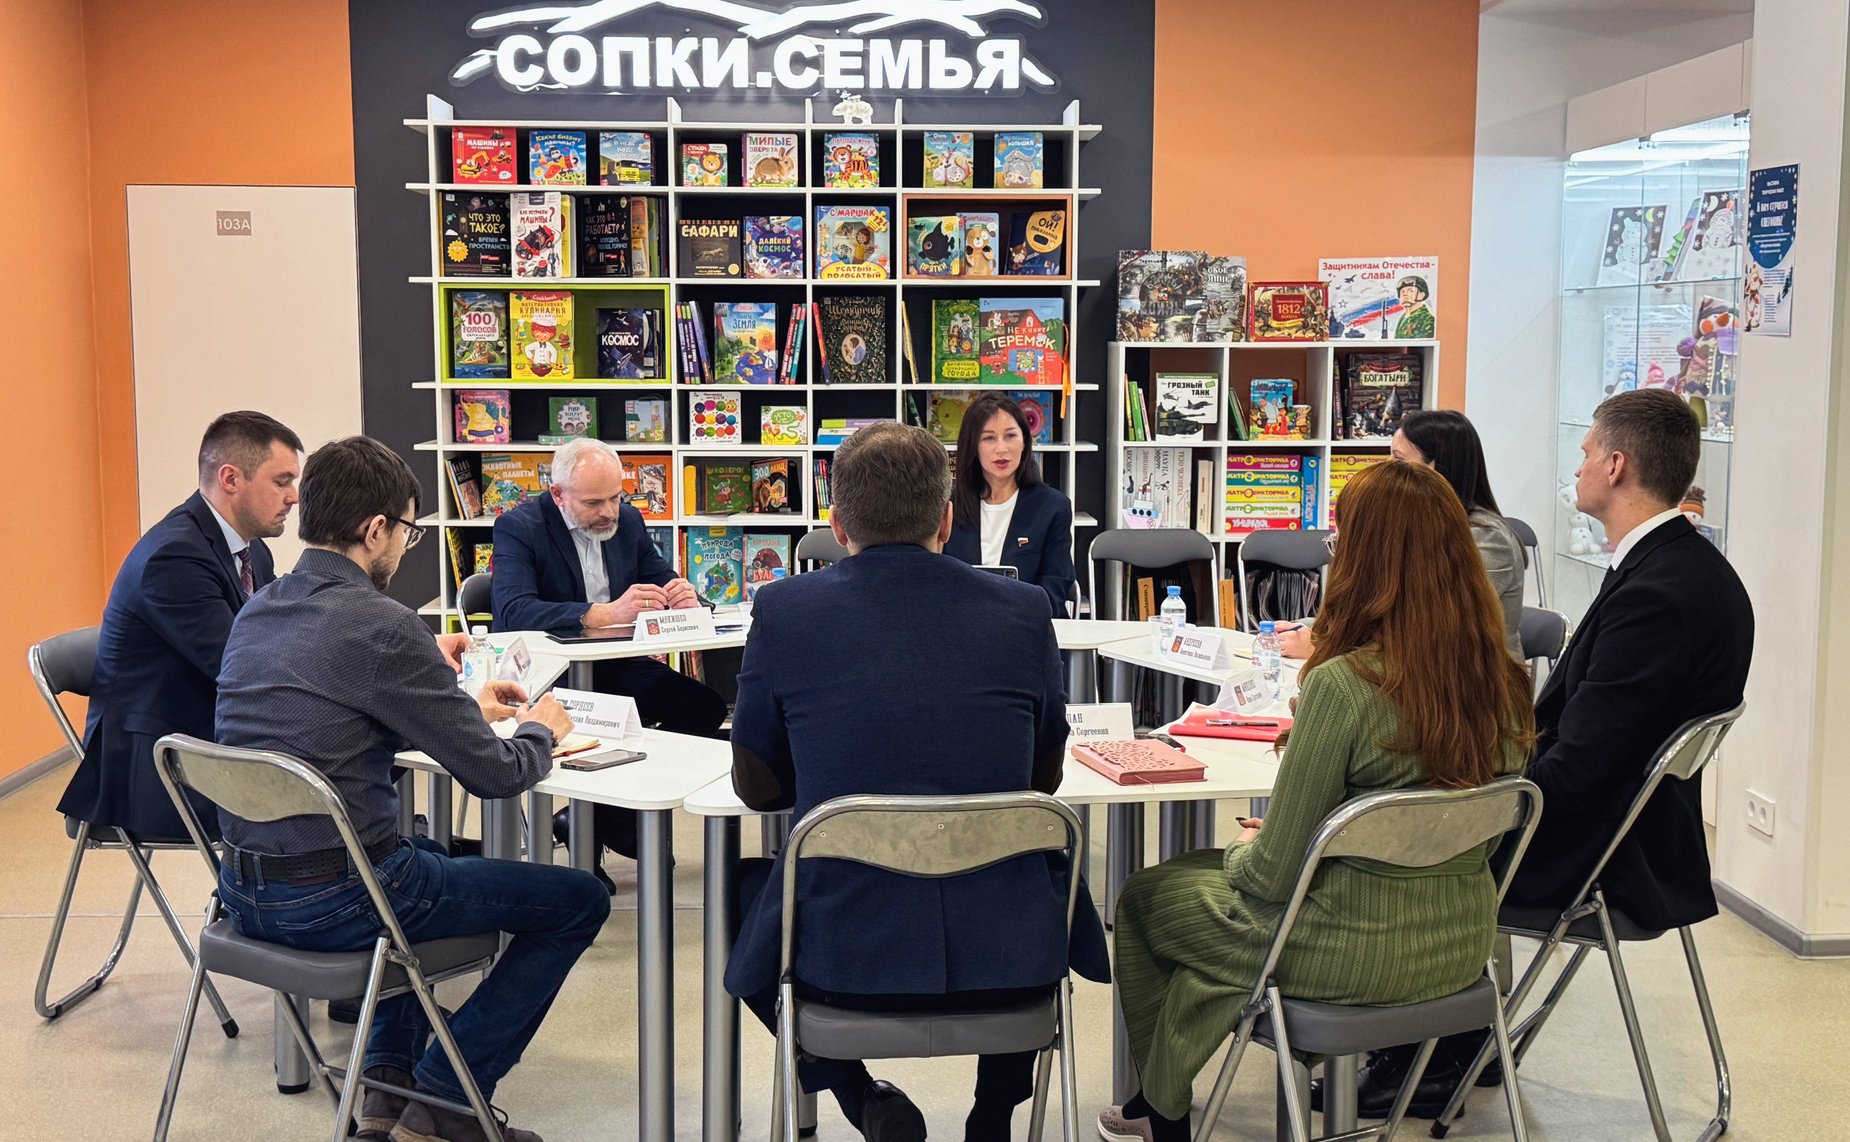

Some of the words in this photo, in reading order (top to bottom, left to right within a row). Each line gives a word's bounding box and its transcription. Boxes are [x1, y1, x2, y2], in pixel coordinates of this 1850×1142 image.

[496, 34, 1020, 88] СОПКИ.СЕМЬЯ
[466, 139, 499, 147] МАШИНЫ
[749, 137, 792, 146] МИЛЫЕ
[468, 212, 484, 222] ЧТО
[485, 213, 501, 222] ЭТО
[837, 209, 876, 218] МАРШАК
[469, 222, 506, 234] ТАКОЕ?
[585, 223, 620, 235] РАБОТАЕТ?
[681, 225, 738, 238] САФАРИ
[468, 242, 511, 250] ПРОСТРАНСТВ
[758, 245, 792, 253] КОСМОС
[919, 262, 948, 273] ПРЯТКИ
[1322, 262, 1380, 272] Защитникам
[1381, 261, 1430, 269] Отечества
[1361, 270, 1396, 280] слава!
[519, 307, 567, 315] КУЛИНАРИЯ
[1277, 303, 1301, 315] 1812
[465, 313, 492, 326] 100
[462, 326, 497, 334] ГОЛОСОВ
[732, 320, 757, 330] ЗЕМЛЯ
[601, 334, 640, 346] КОСМОС
[988, 333, 1056, 350] ТЕРЕМОК
[1363, 373, 1407, 383] БОГАТЫРИ
[1167, 380, 1203, 389] ГРОЗНЫЙ
[481, 461, 523, 471] ЖИВОТНЫЕ
[1161, 450, 1169, 477] НАУКА
[502, 470, 535, 478] ПЛАНЕТЫ
[753, 469, 771, 480] 300
[701, 539, 736, 550] ПРИРОДА
[703, 552, 730, 560] ПОГОДА
[1076, 727, 1109, 737] Сергеевна
